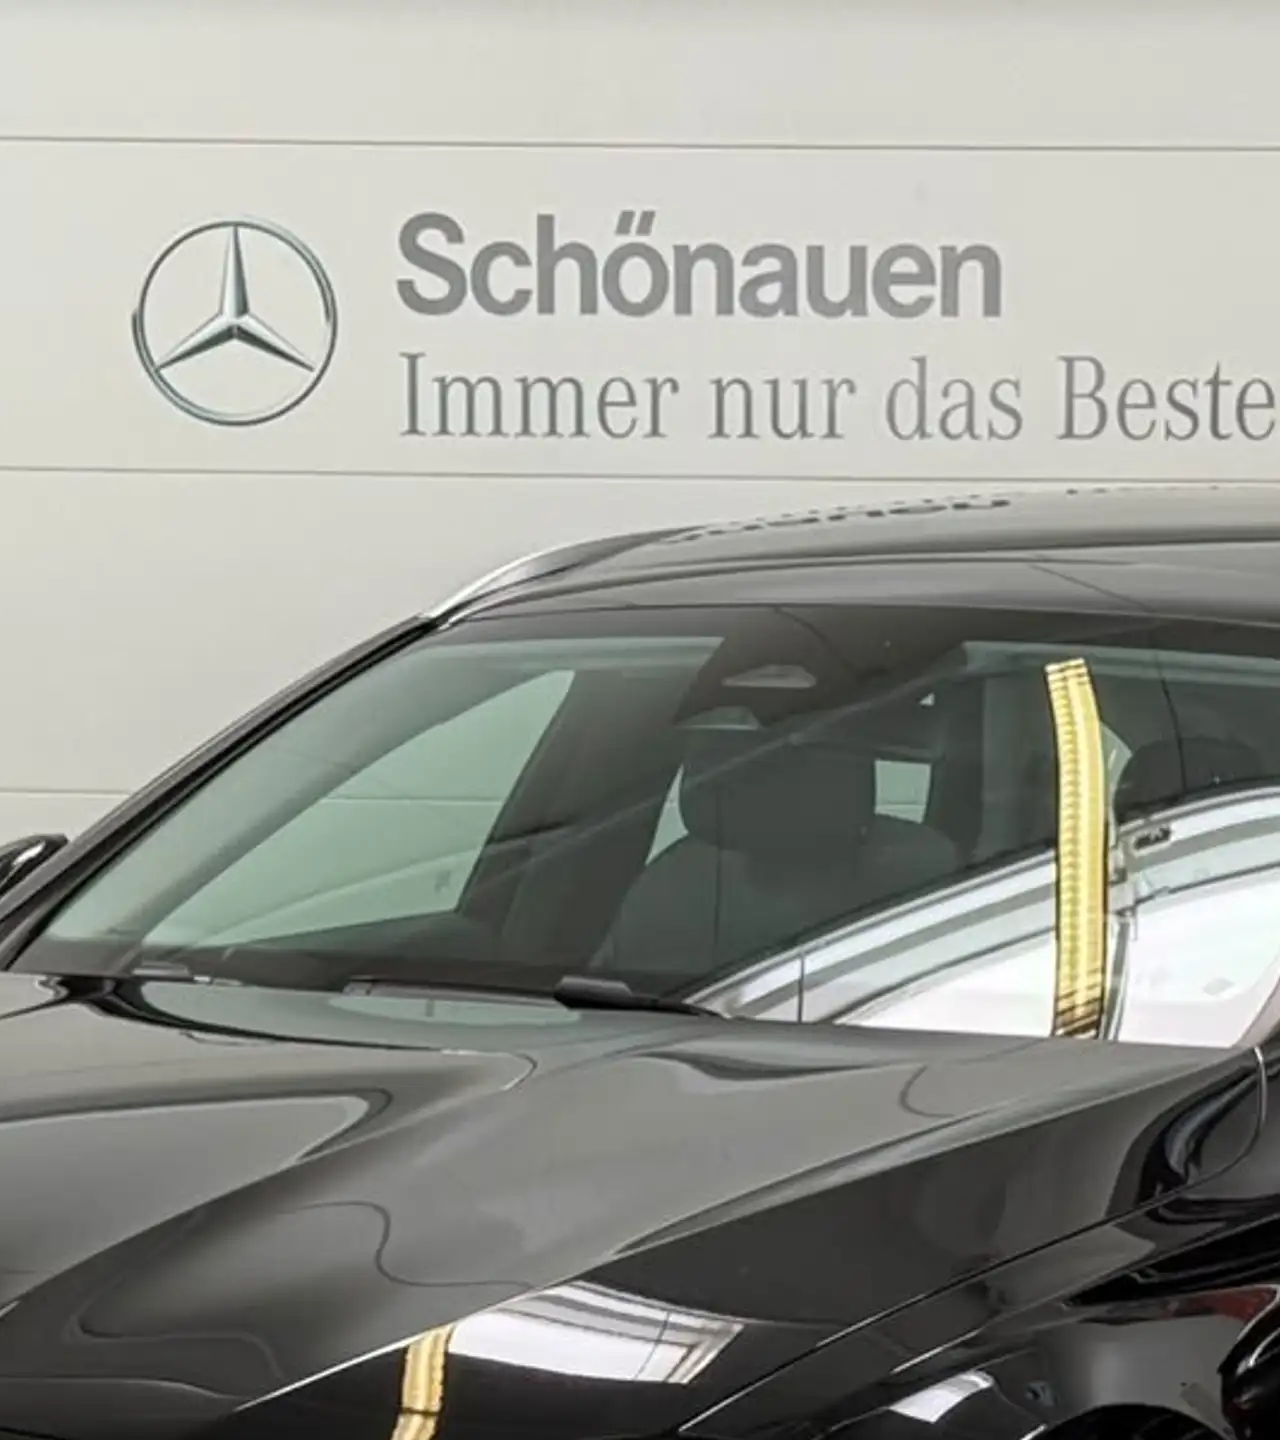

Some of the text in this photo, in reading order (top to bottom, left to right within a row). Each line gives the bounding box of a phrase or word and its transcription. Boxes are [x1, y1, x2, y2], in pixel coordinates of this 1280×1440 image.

[396, 209, 1002, 319] Schönauen
[399, 351, 680, 440] Immer
[707, 377, 857, 441] nur
[885, 355, 1024, 441] das
